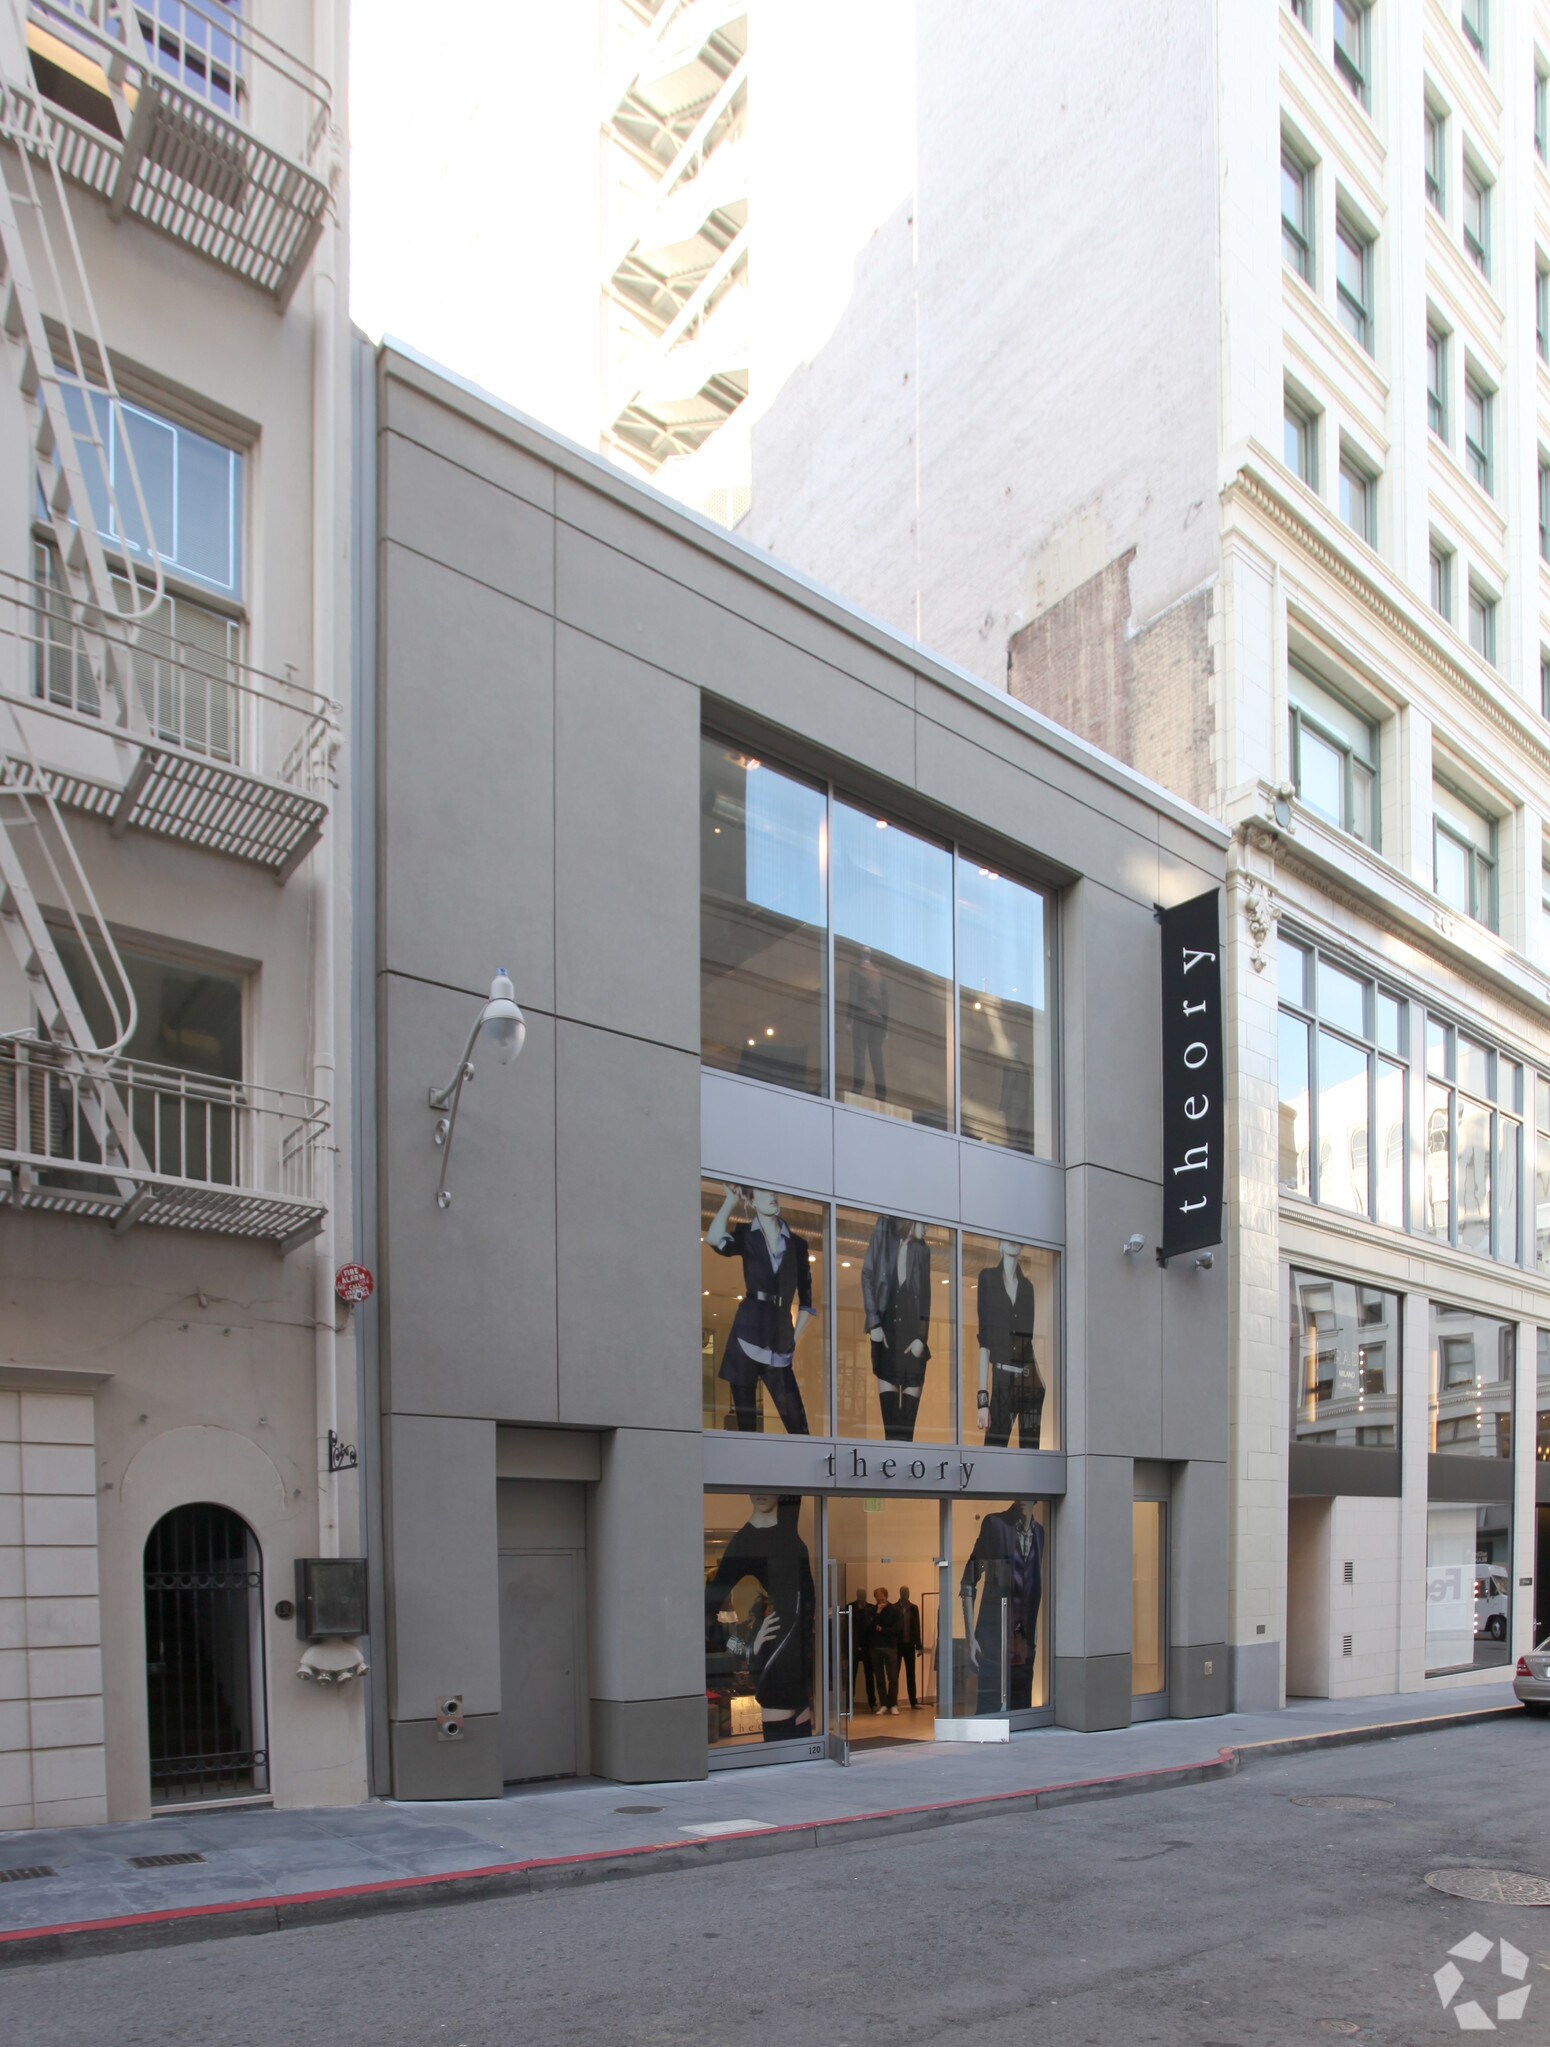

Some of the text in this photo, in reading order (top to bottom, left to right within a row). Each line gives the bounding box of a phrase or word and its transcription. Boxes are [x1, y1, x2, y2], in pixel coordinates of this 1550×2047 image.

[1173, 946, 1216, 1213] theory
[341, 1272, 366, 1284] ALARM
[343, 1267, 359, 1277] FIRE
[826, 1448, 975, 1489] theory
[808, 1745, 821, 1755] 120
